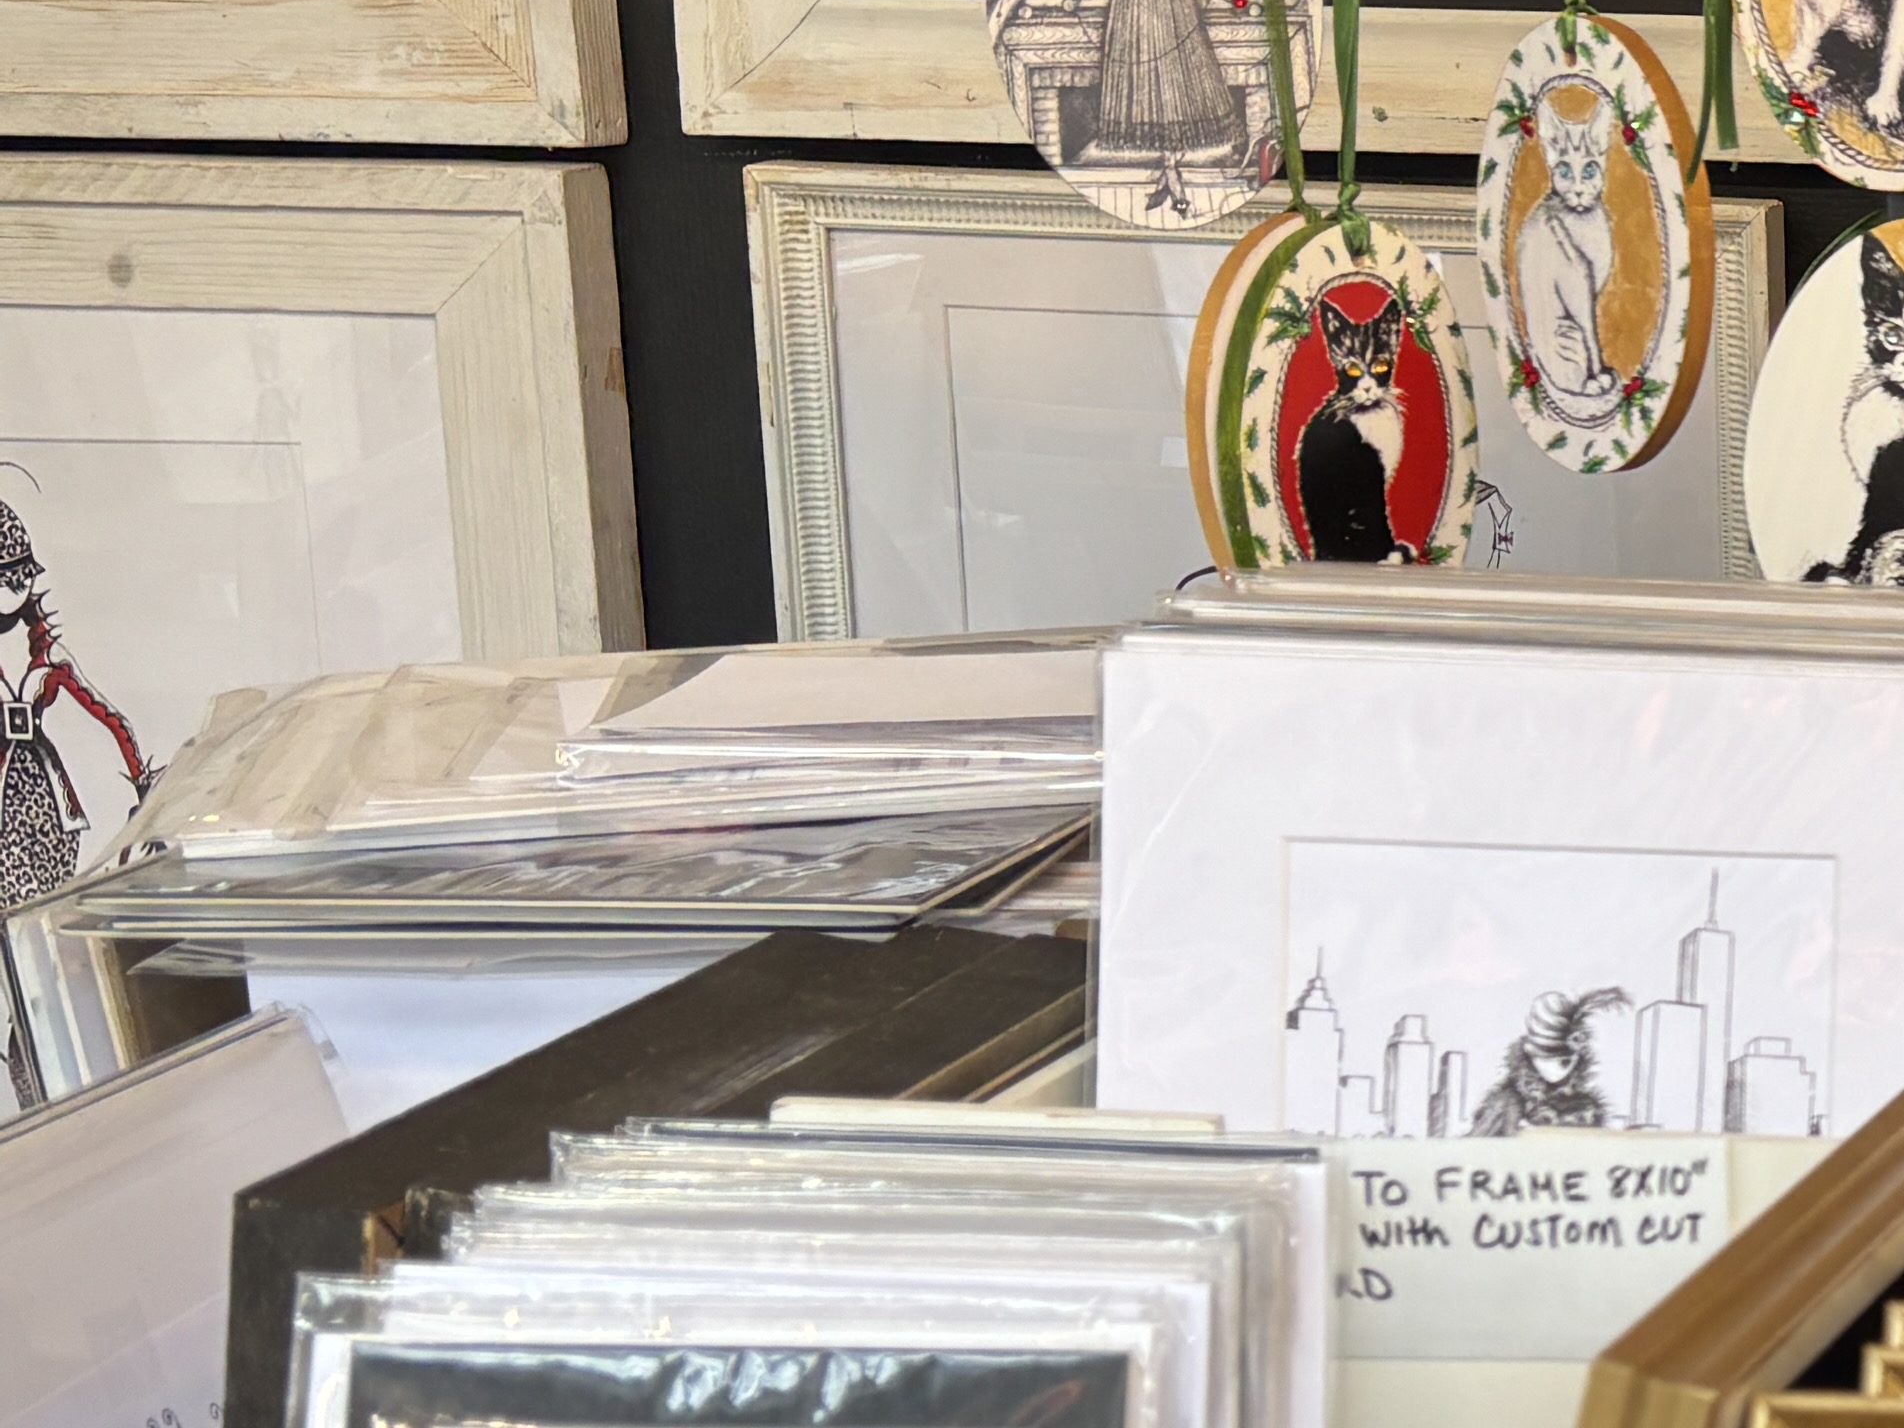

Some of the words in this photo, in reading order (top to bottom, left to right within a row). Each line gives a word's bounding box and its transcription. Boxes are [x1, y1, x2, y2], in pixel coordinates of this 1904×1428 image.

[1351, 1169, 1408, 1208] TO
[1433, 1165, 1589, 1204] FRAME
[1636, 1212, 1706, 1244] CUT
